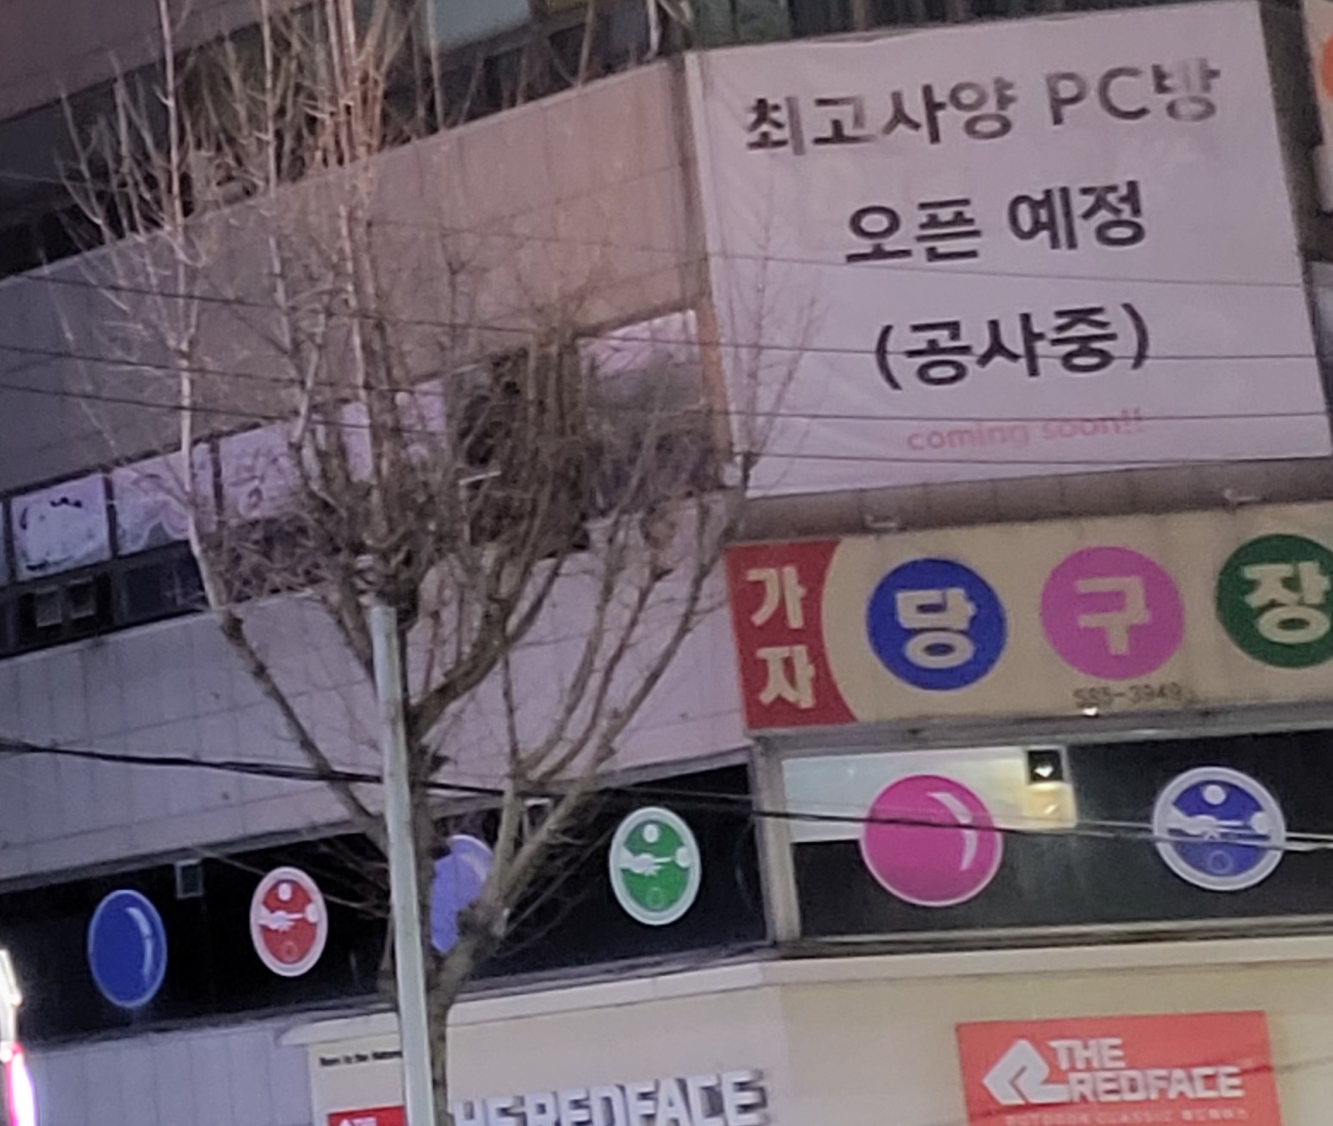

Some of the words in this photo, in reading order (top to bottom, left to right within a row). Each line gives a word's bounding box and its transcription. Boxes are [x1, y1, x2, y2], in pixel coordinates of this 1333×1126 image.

[745, 76, 1020, 157] 최고사양
[1045, 58, 1222, 127] PC방
[845, 197, 983, 264] 오픈
[1006, 179, 1147, 251] 예정
[875, 301, 1150, 391] (공사중)
[905, 424, 1031, 453] coming
[746, 565, 818, 710] 가자
[893, 559, 1332, 672] 당구장
[1047, 1036, 1127, 1071] THE
[1065, 1065, 1247, 1104] REDFACE
